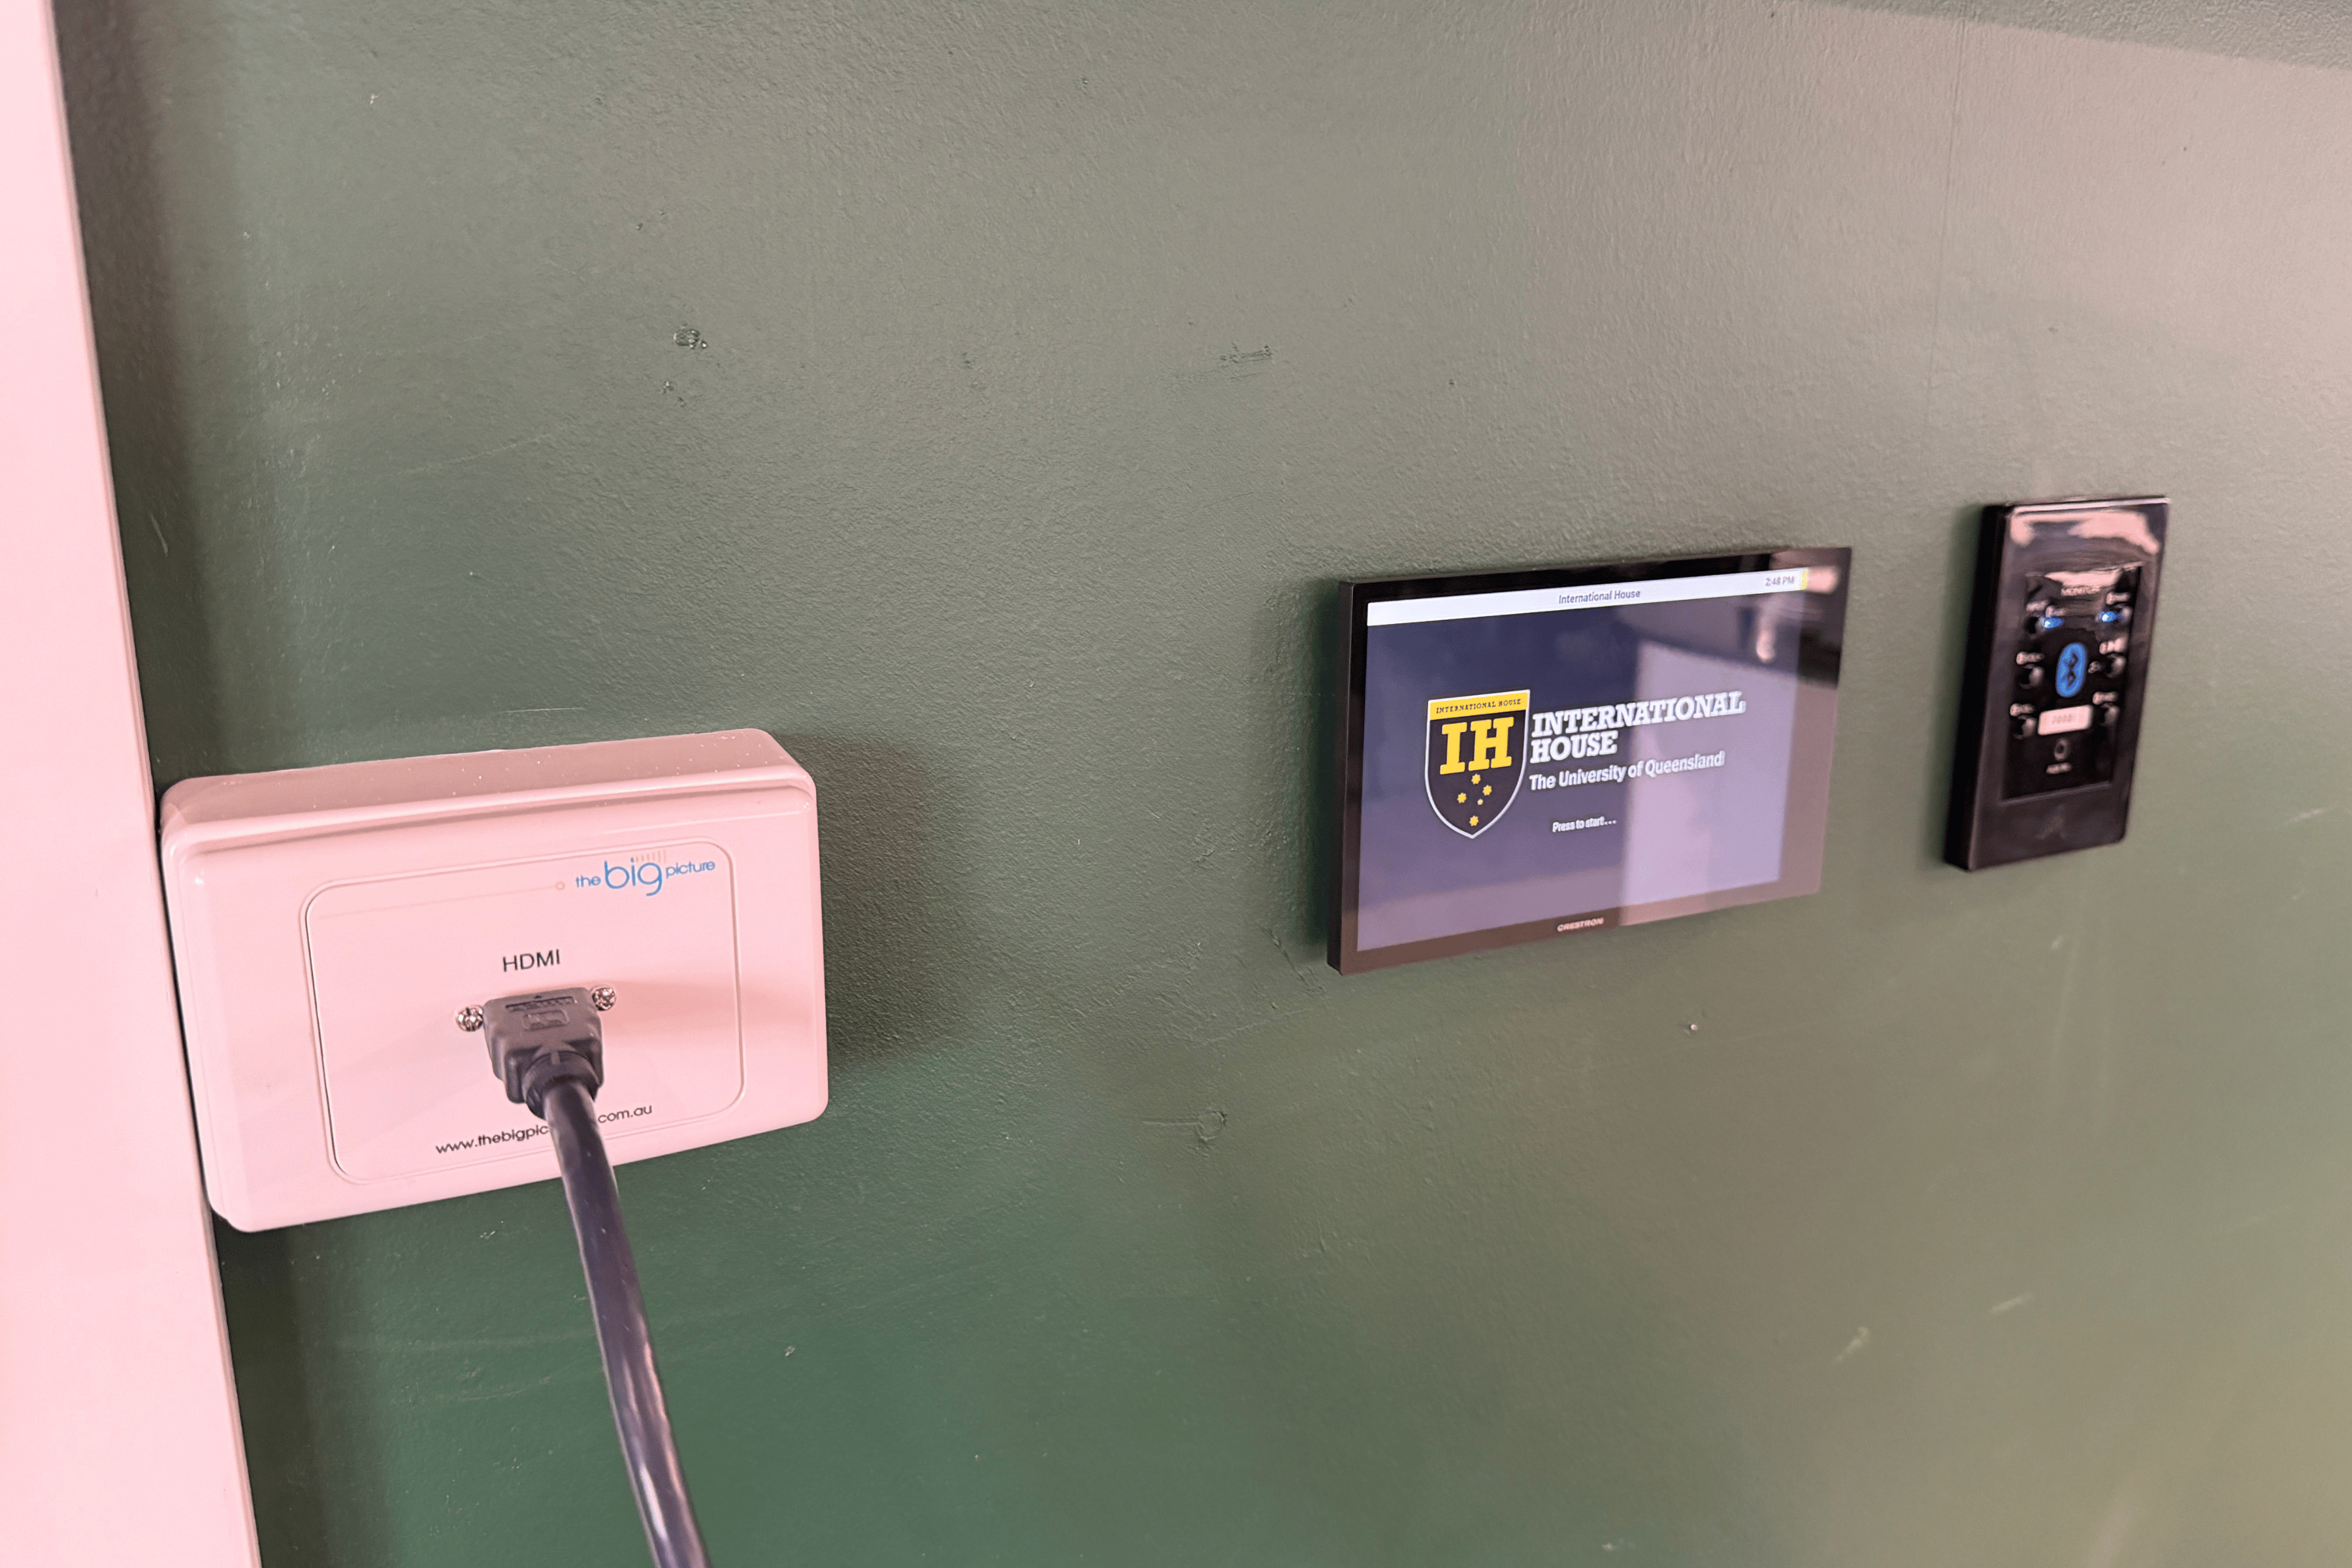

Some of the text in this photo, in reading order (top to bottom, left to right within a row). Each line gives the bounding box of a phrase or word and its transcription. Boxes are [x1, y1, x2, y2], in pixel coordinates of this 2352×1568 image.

[1559, 590, 1641, 604] International House
[1436, 702, 1496, 714] INTERNATIONAL
[1531, 691, 1746, 738] INTERNATIONAL
[1440, 717, 1514, 775] IH
[1529, 730, 1618, 763] HOUSE
[1529, 751, 1725, 791] The University of Queensland
[1552, 821, 1575, 833] Press
[1576, 819, 1585, 829] to
[576, 857, 716, 896] the big picture
[502, 949, 561, 972] HDMI
